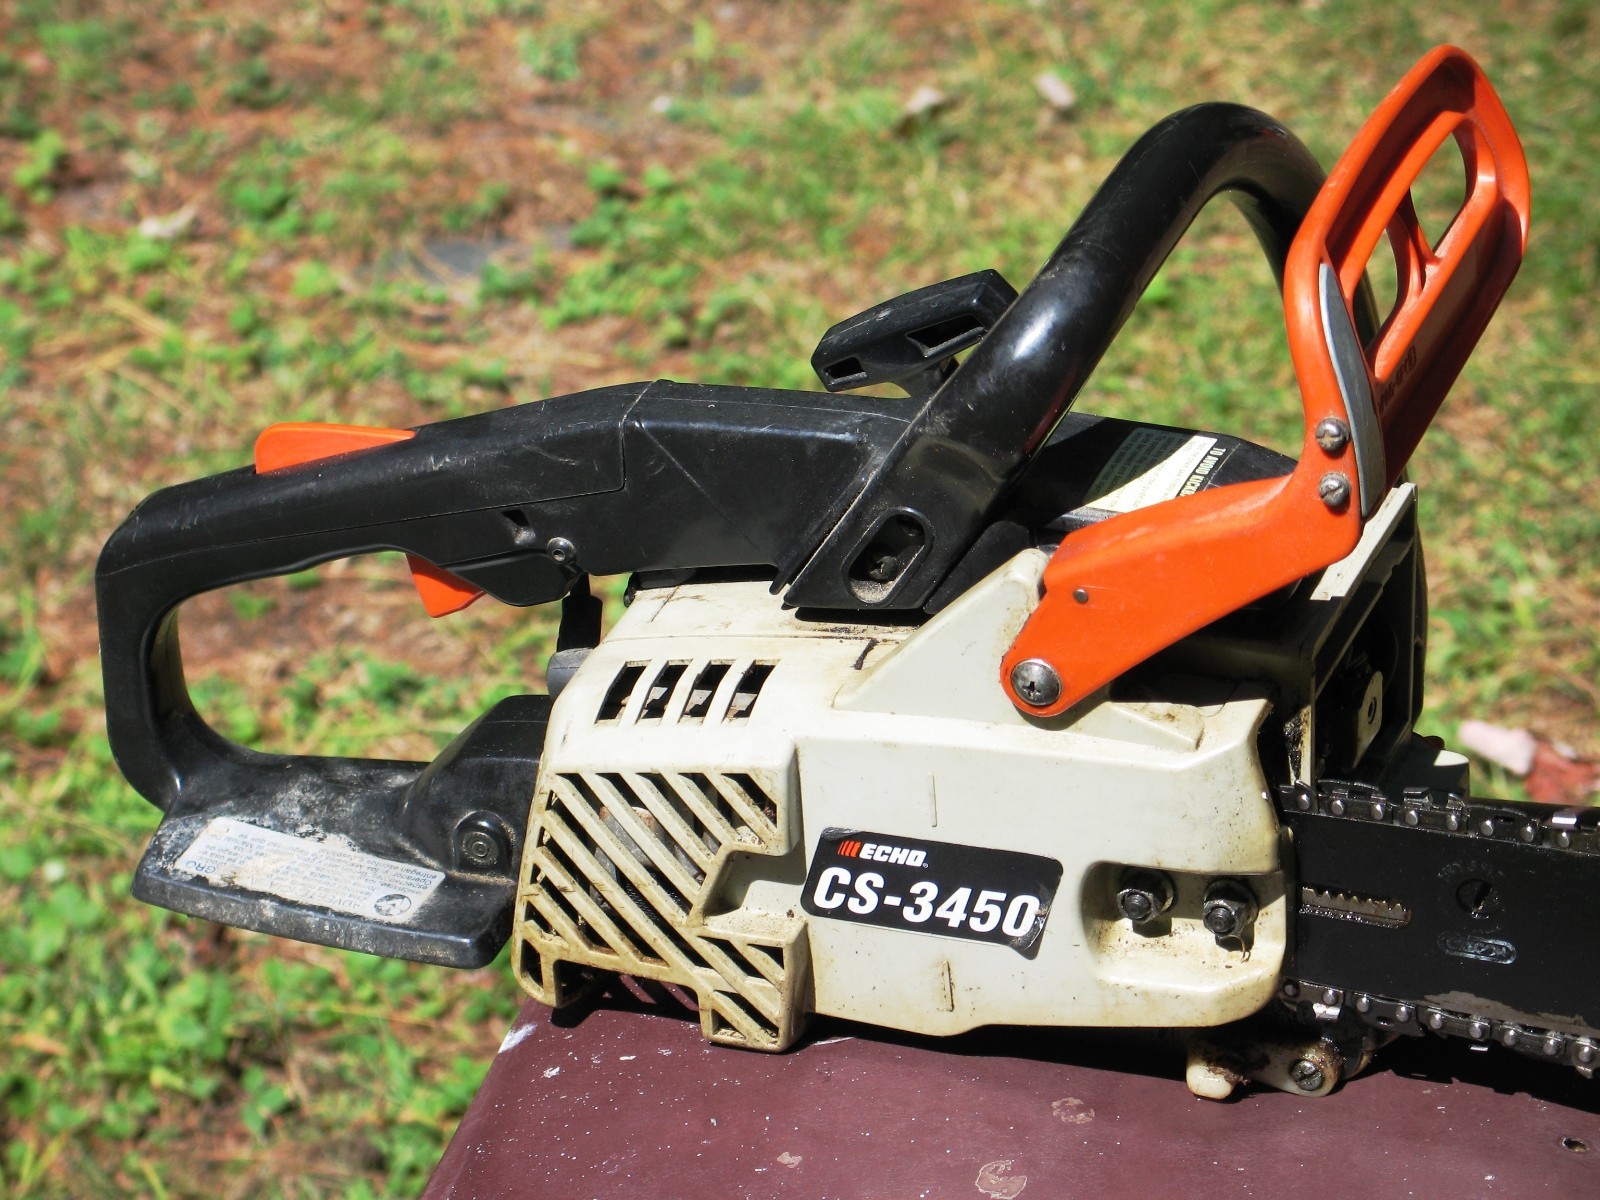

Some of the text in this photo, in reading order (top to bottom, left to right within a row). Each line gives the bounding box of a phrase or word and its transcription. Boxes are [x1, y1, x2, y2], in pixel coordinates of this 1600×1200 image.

[1179, 447, 1227, 497] TO AVOID KICKB
[858, 842, 927, 868] ECHO
[813, 866, 1041, 937] CS-3450
